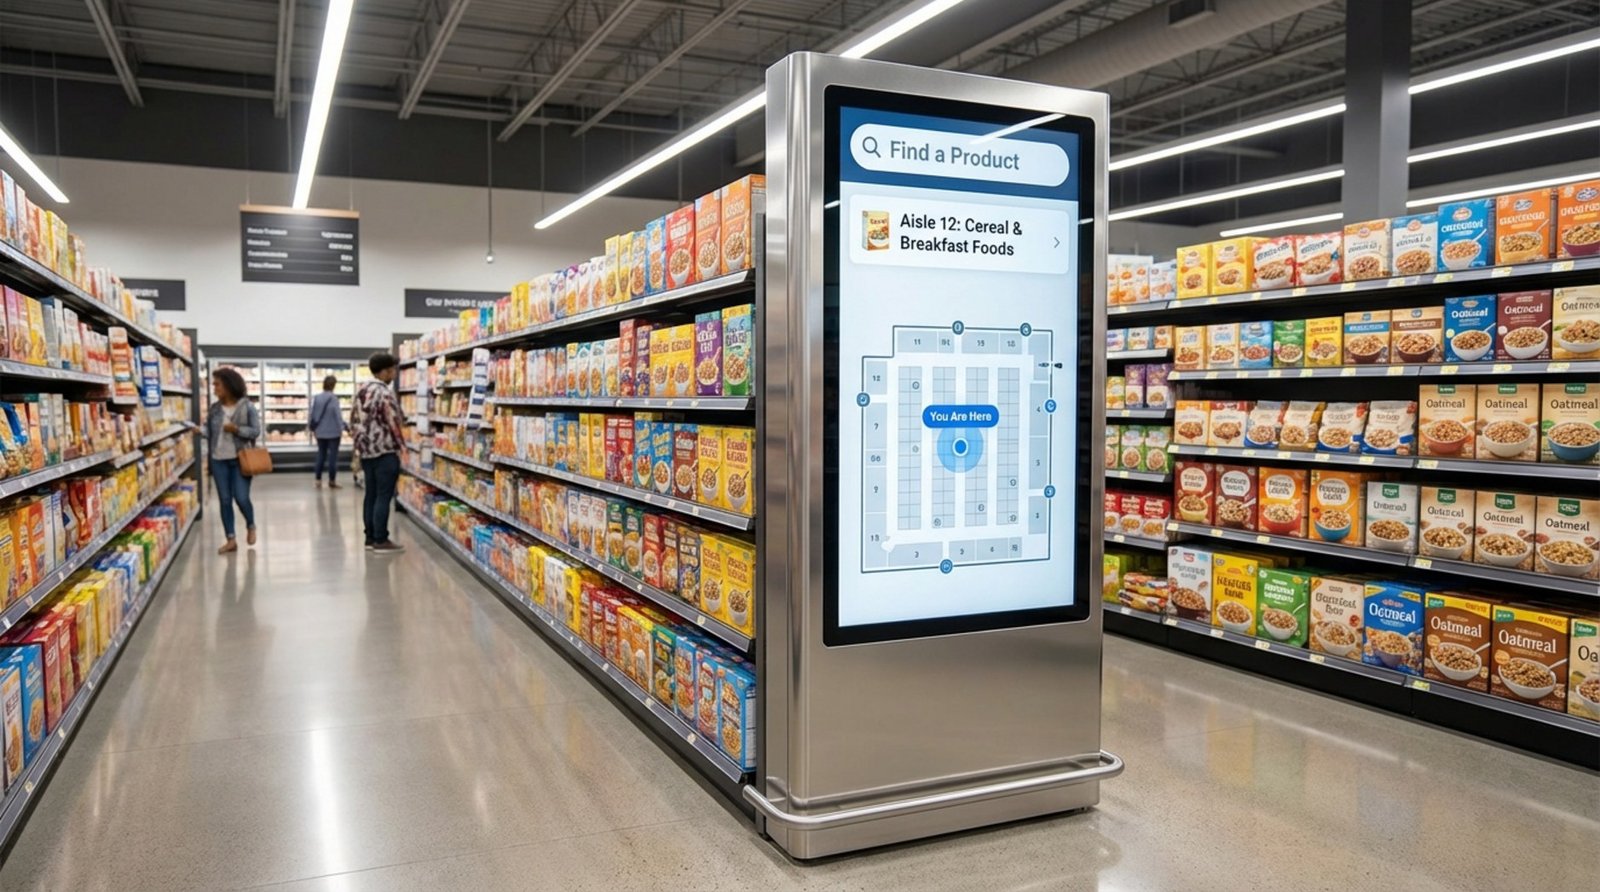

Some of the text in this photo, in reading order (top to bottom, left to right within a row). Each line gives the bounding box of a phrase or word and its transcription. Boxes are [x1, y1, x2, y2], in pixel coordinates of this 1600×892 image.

[890, 140, 1020, 170] Find a Product
[900, 213, 1022, 235] Aisle 12: Cereal &
[900, 236, 1015, 256] Breakfast Foods
[930, 412, 992, 422] You Are Here
